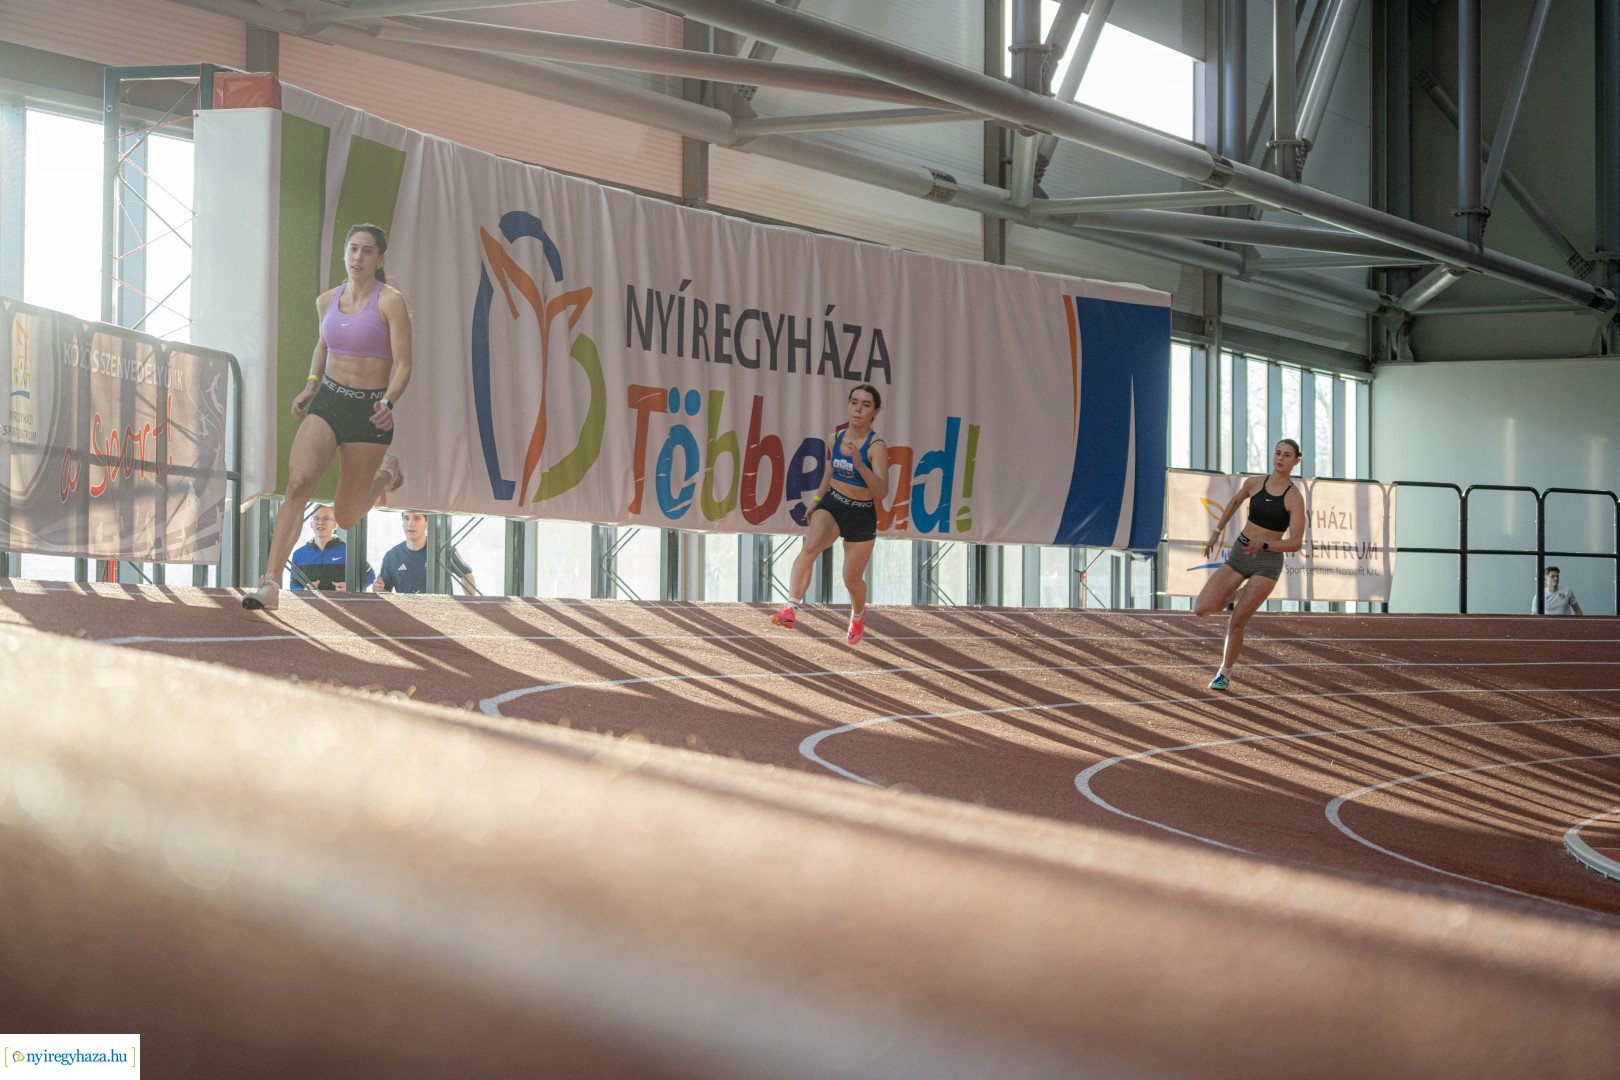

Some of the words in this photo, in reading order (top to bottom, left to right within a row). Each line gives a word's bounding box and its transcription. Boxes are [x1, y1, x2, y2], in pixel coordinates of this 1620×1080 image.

[626, 278, 892, 385] NYÍREGYHÁZA
[336, 386, 366, 399] PRO
[60, 445, 83, 503] a
[89, 393, 173, 511] Sport!
[831, 491, 851, 505] NIKE
[1285, 564, 1335, 577] Sportcentrum
